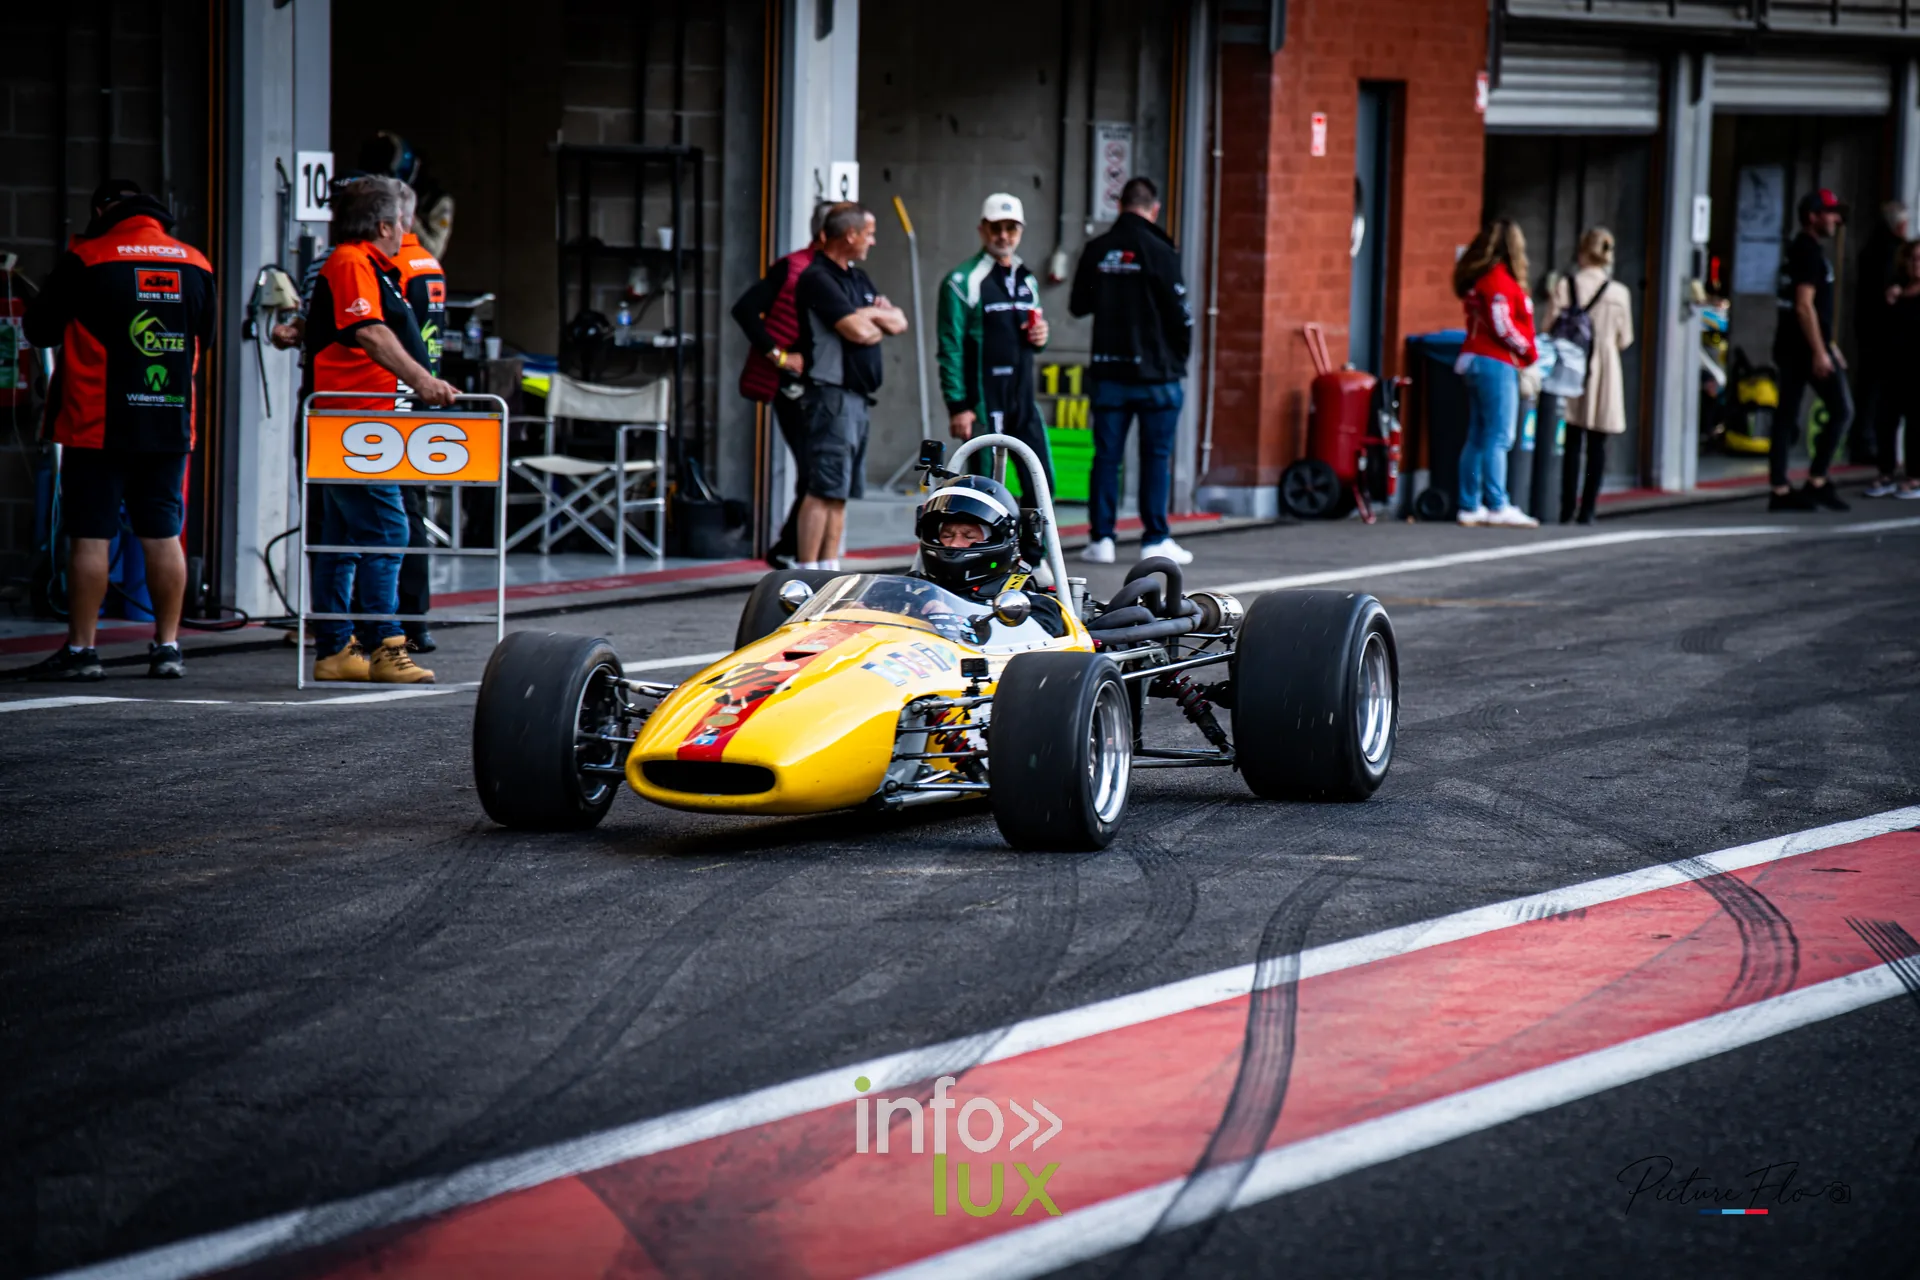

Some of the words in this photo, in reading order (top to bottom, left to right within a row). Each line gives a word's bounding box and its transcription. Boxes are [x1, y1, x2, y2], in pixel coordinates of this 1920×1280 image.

[304, 163, 327, 209] 10
[117, 245, 147, 254] FINN
[144, 275, 173, 288] KTM
[139, 291, 161, 299] RACING
[163, 292, 180, 300] TEAM
[144, 331, 184, 349] PATZE
[1041, 363, 1083, 395] 11
[1056, 397, 1090, 429] IN
[342, 421, 469, 475] 96
